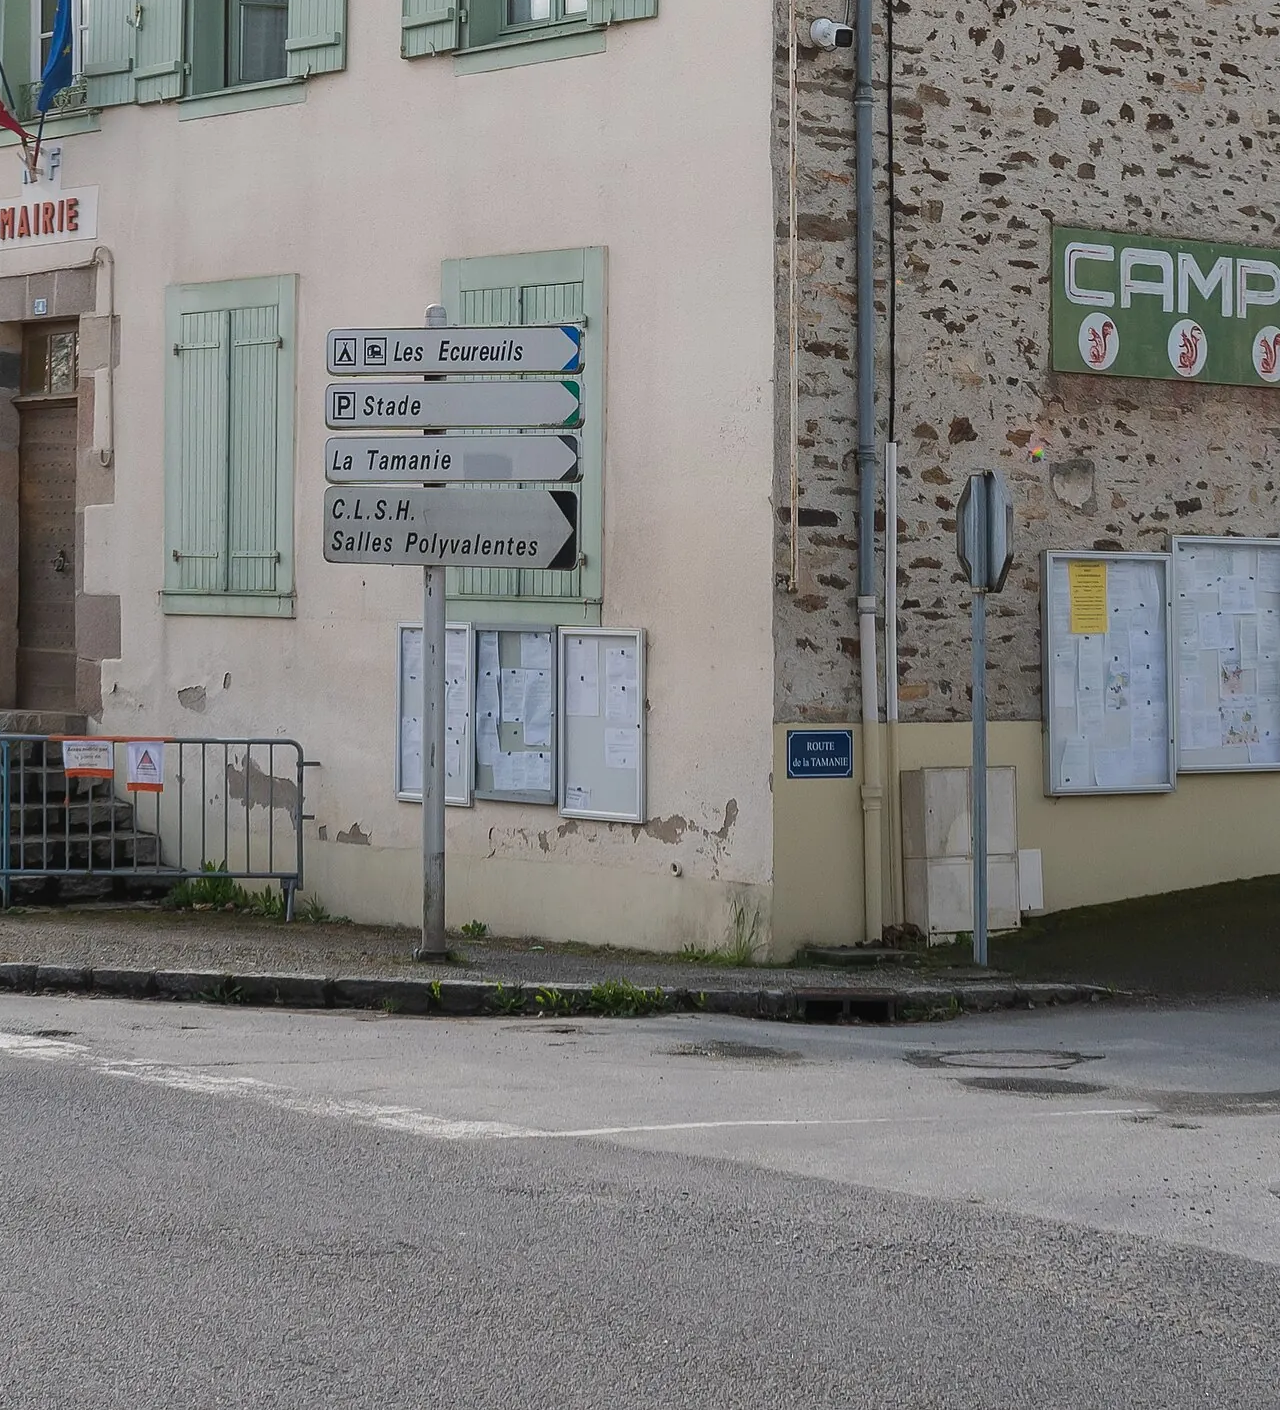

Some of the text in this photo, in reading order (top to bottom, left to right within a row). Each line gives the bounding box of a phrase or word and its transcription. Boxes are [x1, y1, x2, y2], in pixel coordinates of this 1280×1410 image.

[0, 197, 79, 241] MAIRIE
[393, 340, 523, 362] Les Ecureuils
[337, 394, 421, 416] P Stade
[332, 449, 452, 471] La Tamanie
[332, 499, 416, 521] C.L.S.H.
[331, 530, 538, 559] Salles Polyvalentes
[806, 741, 835, 751] ROUTE
[792, 757, 849, 767] de la TAMANIE
